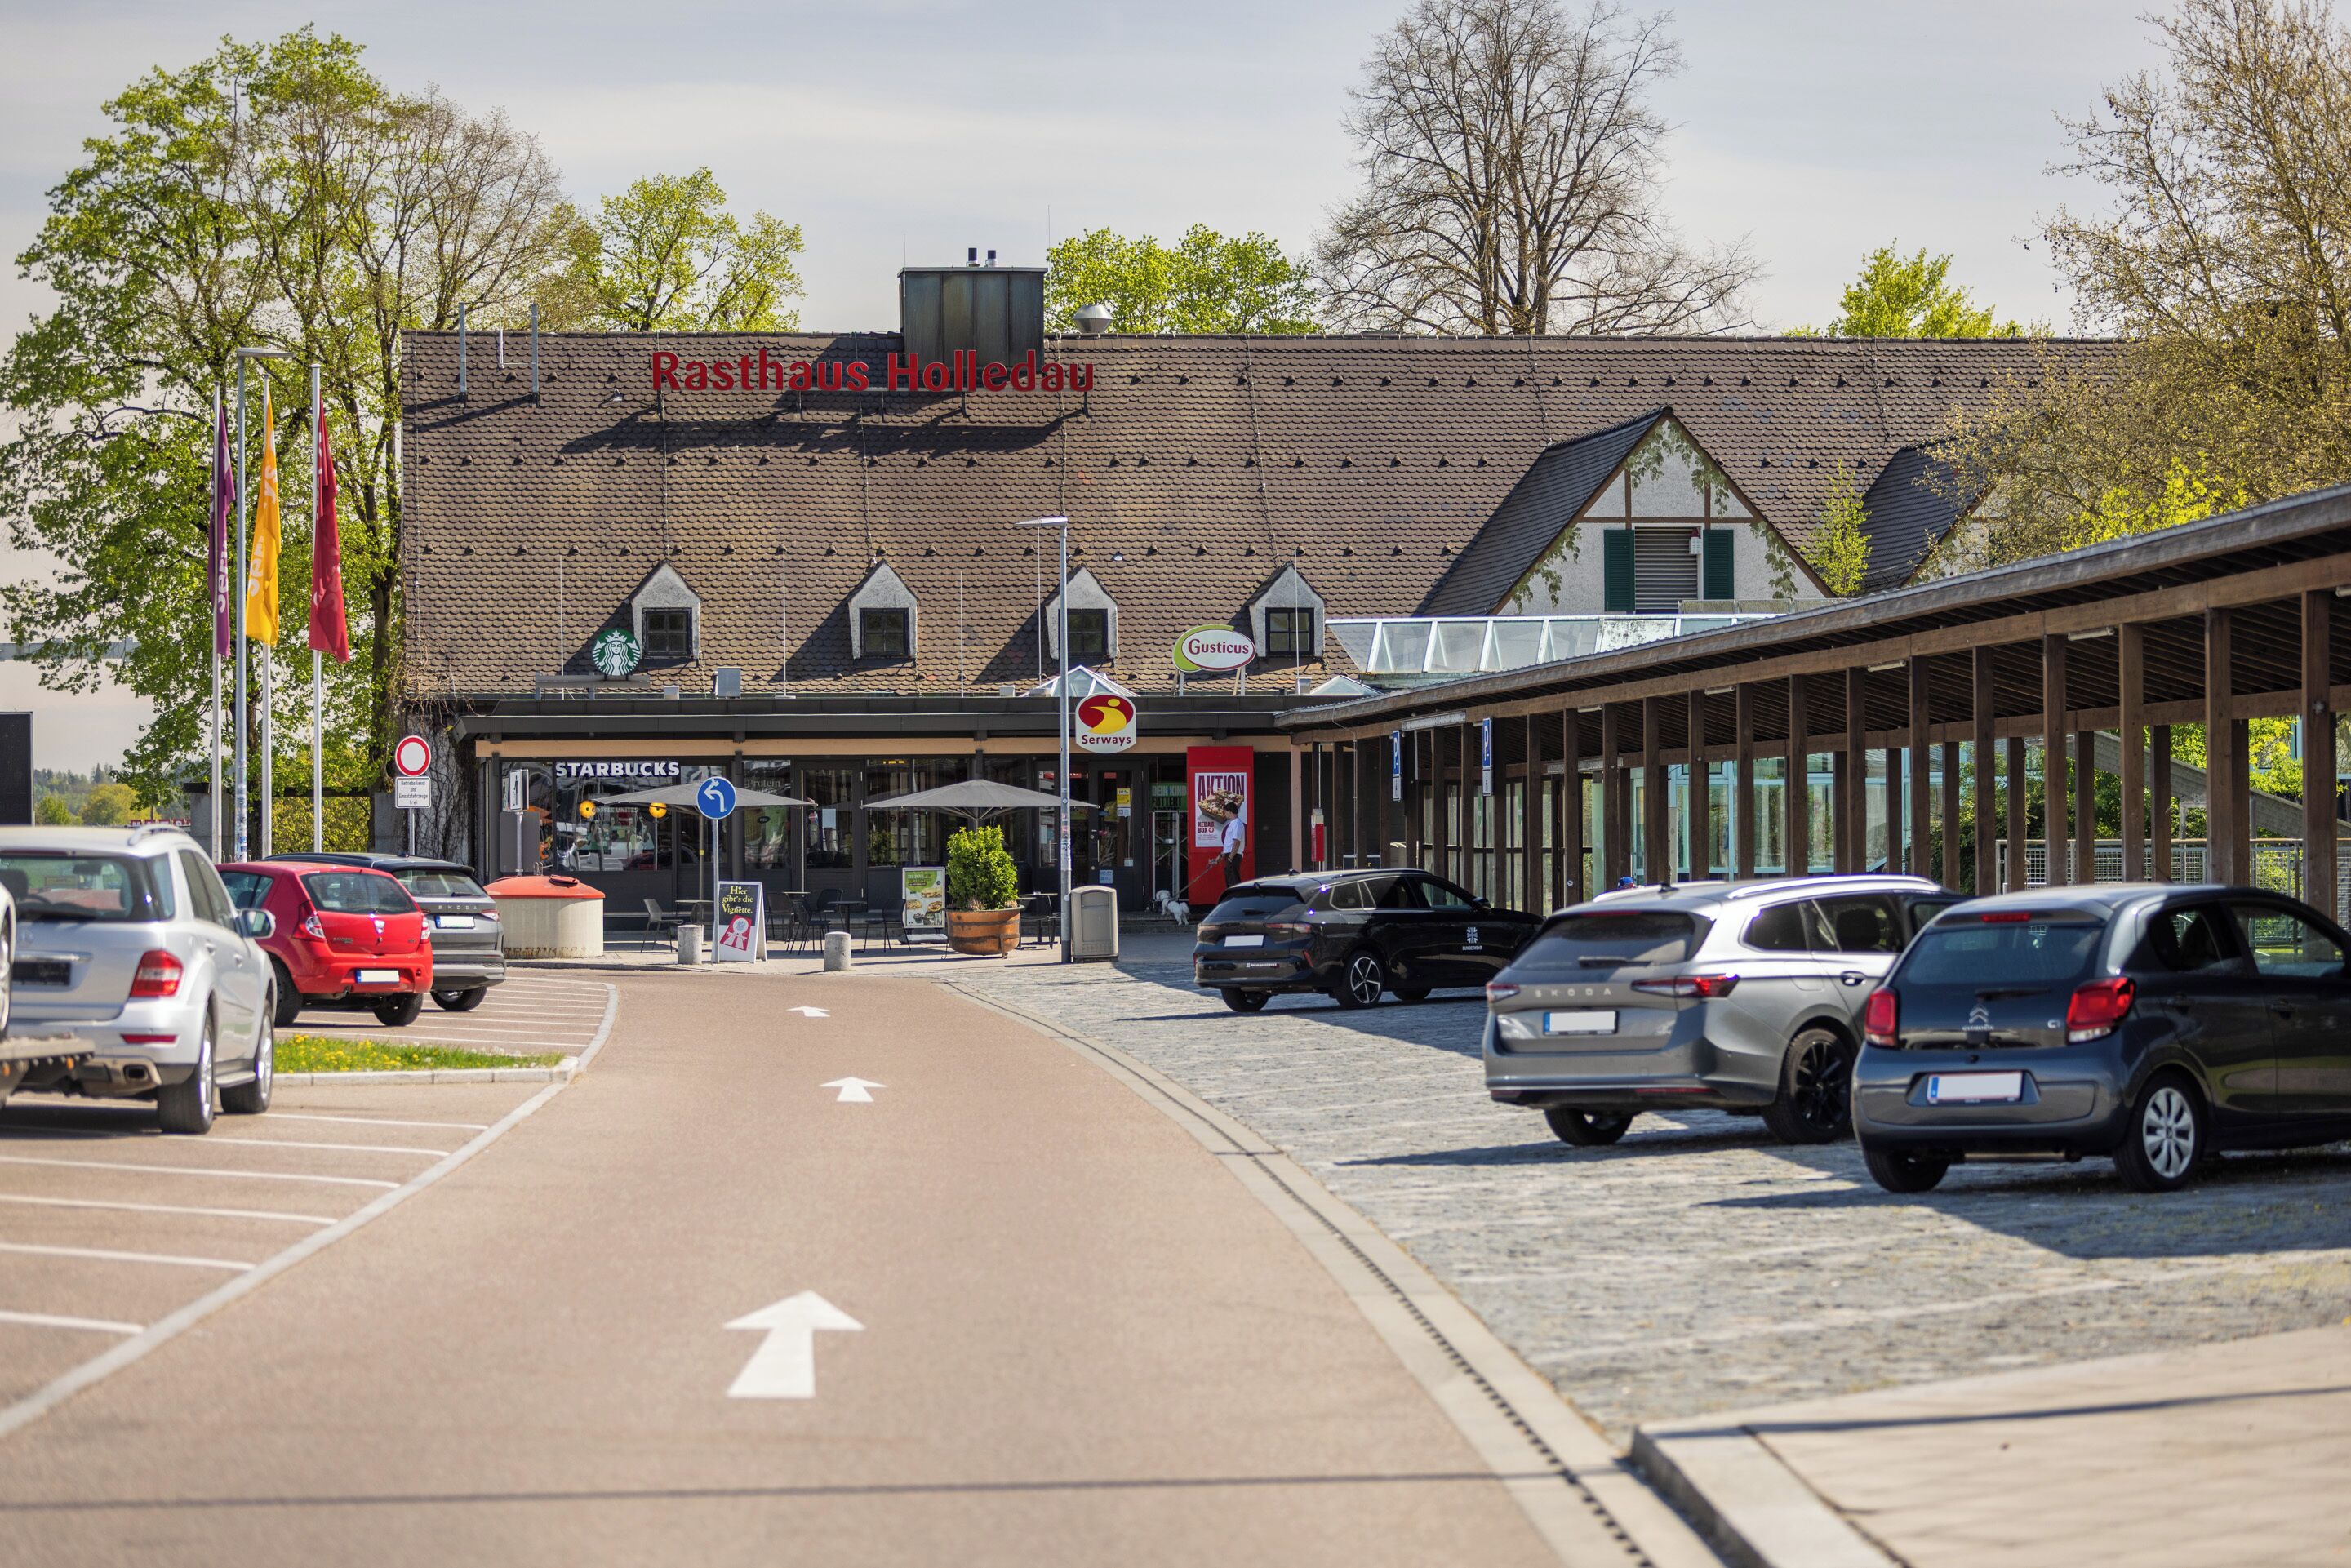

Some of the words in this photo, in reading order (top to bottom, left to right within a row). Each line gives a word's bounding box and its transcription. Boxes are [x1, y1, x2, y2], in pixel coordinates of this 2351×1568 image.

[654, 349, 869, 392] Rasthaus
[888, 349, 1094, 392] Holledau
[1188, 638, 1249, 655] Gusticus
[1082, 735, 1131, 747] Serways
[556, 762, 680, 776] STARBUCKS
[1152, 785, 1167, 797] DEIN
[1170, 785, 1187, 797] KIND
[1198, 775, 1245, 801] AKTION
[730, 886, 748, 895] Hier
[722, 895, 741, 904] gibt's
[722, 904, 753, 914] Vignette.
